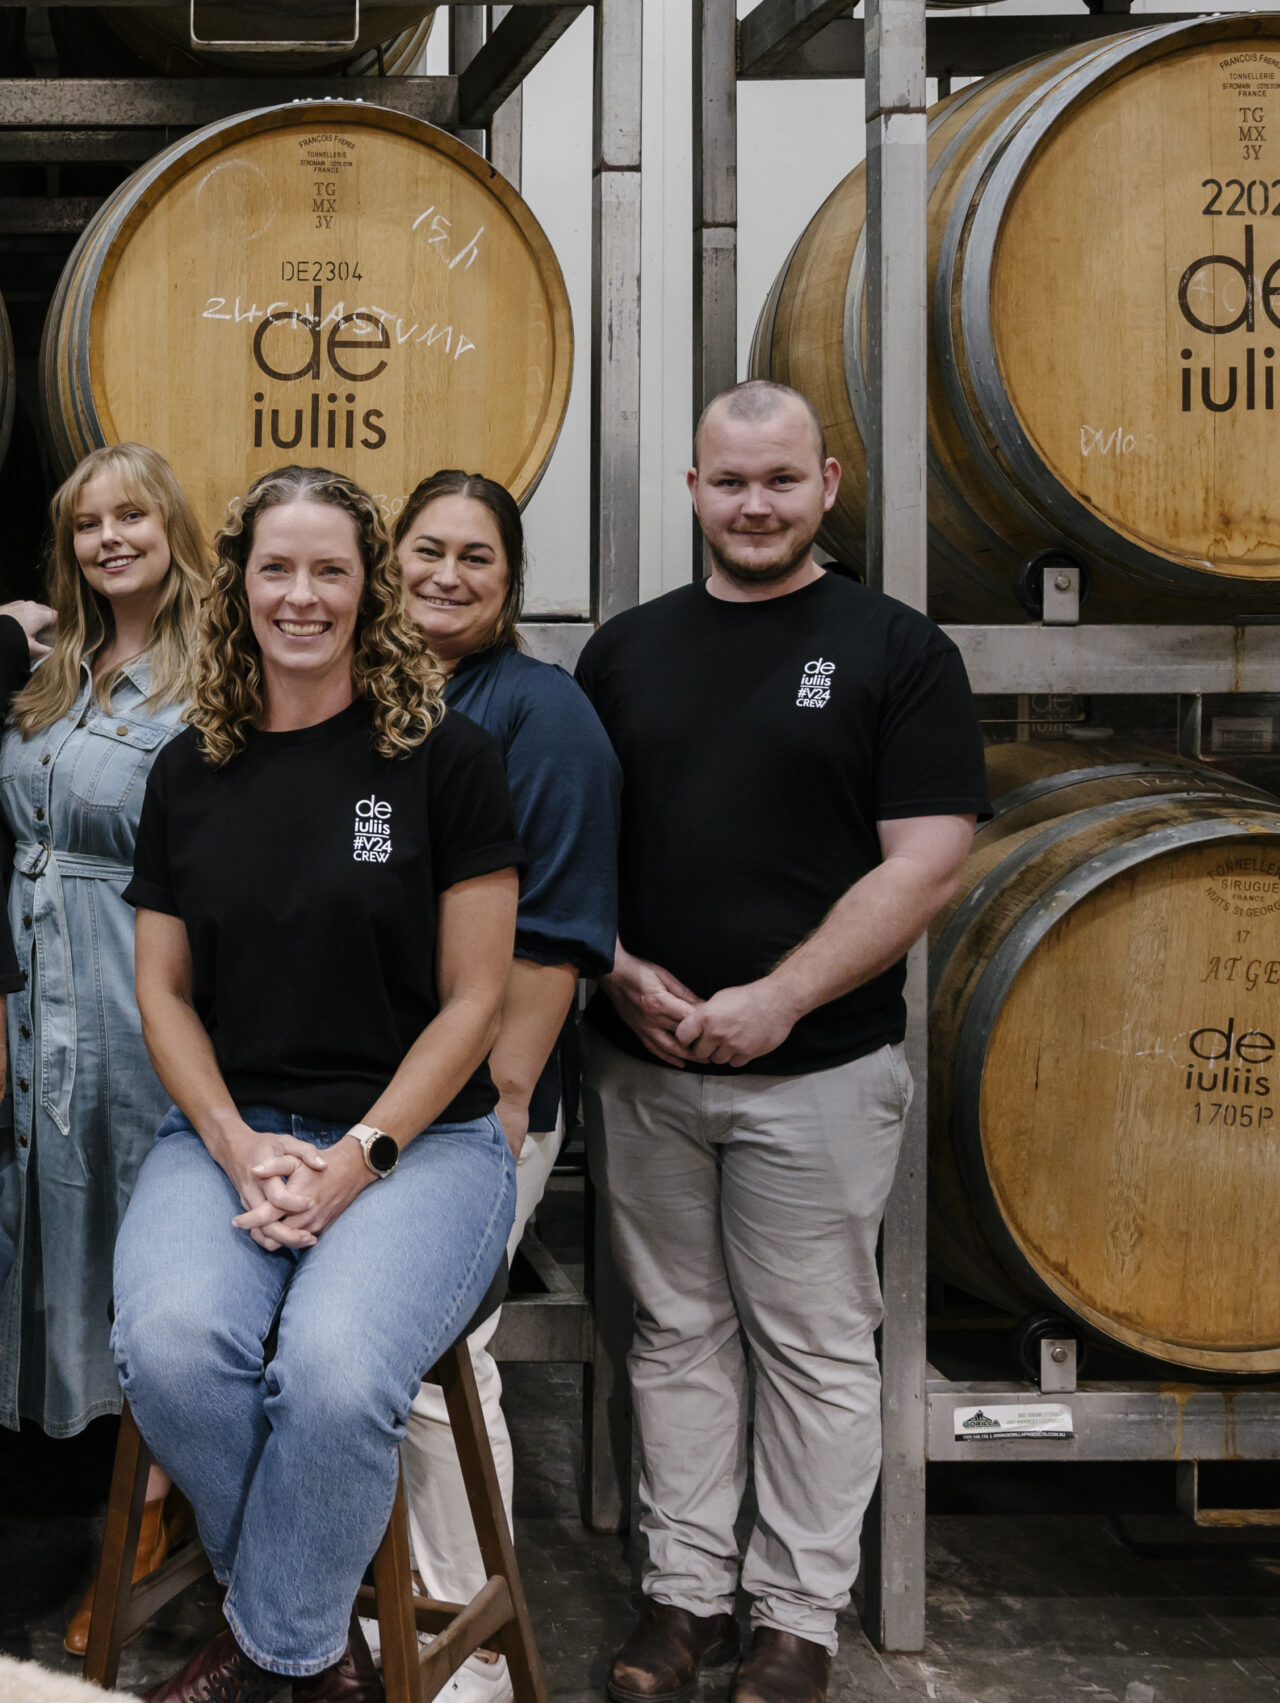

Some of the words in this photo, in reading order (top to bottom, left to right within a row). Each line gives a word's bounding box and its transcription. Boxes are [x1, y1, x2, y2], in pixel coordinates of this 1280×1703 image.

[1239, 107, 1264, 123] TG
[1238, 126, 1266, 141] MX
[1242, 145, 1262, 160] 3Y
[313, 182, 336, 197] TG
[312, 199, 337, 212] MX
[315, 215, 333, 229] 3Y
[281, 261, 363, 282] DE2304
[253, 285, 391, 382] de
[253, 391, 387, 450] iuliis
[804, 657, 836, 675] de
[801, 674, 831, 687] iuliis
[797, 688, 831, 701] #V24
[796, 698, 827, 709] CREW
[355, 794, 392, 819] de
[354, 817, 390, 835] iuliis
[353, 836, 393, 853] #V24
[353, 850, 390, 863] CREW
[1205, 887, 1231, 912] NUITS
[1232, 893, 1264, 902] FRANCE
[1237, 929, 1250, 943] 17
[1189, 1017, 1276, 1064] de
[1186, 1064, 1271, 1096] iuliis
[1194, 1102, 1274, 1128] 1705P
